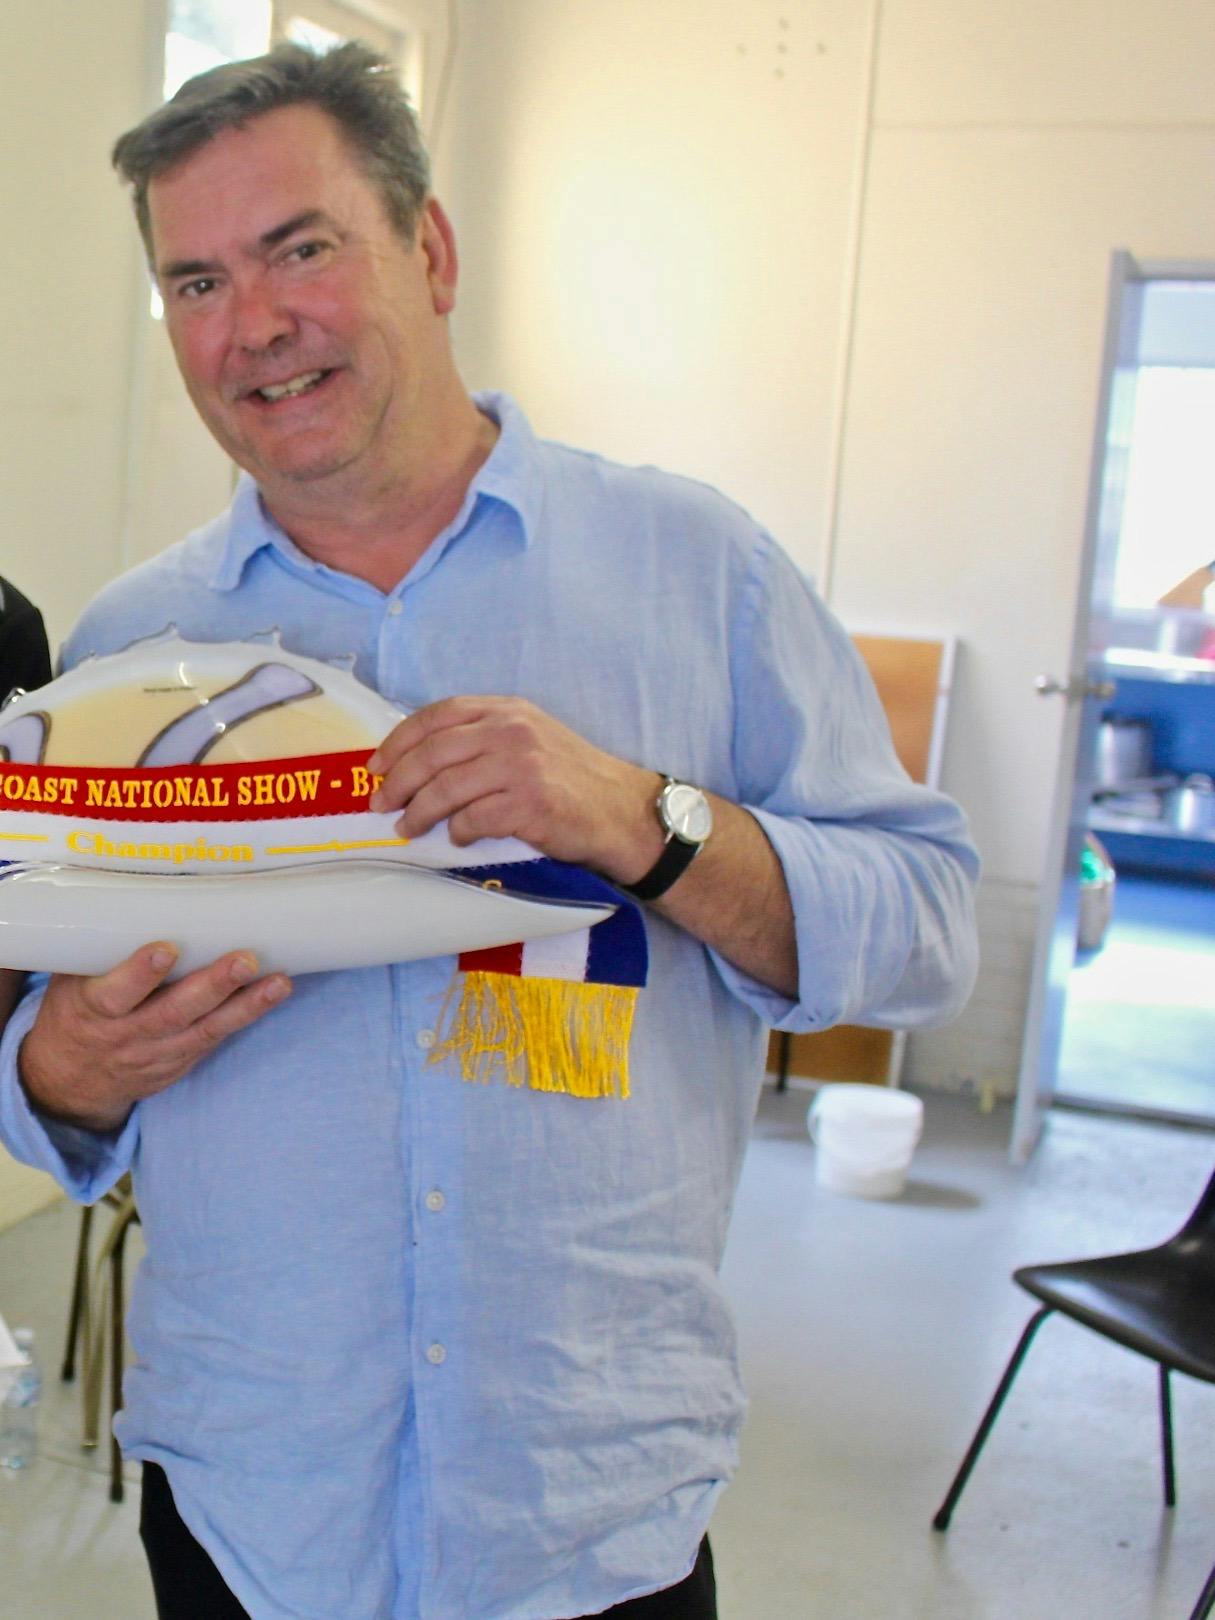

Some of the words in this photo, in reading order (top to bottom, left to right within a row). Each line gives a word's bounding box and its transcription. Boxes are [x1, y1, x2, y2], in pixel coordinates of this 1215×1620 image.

[85, 777, 229, 808] NATIONAL
[237, 769, 321, 805] SHOW
[67, 830, 254, 864] Champion
